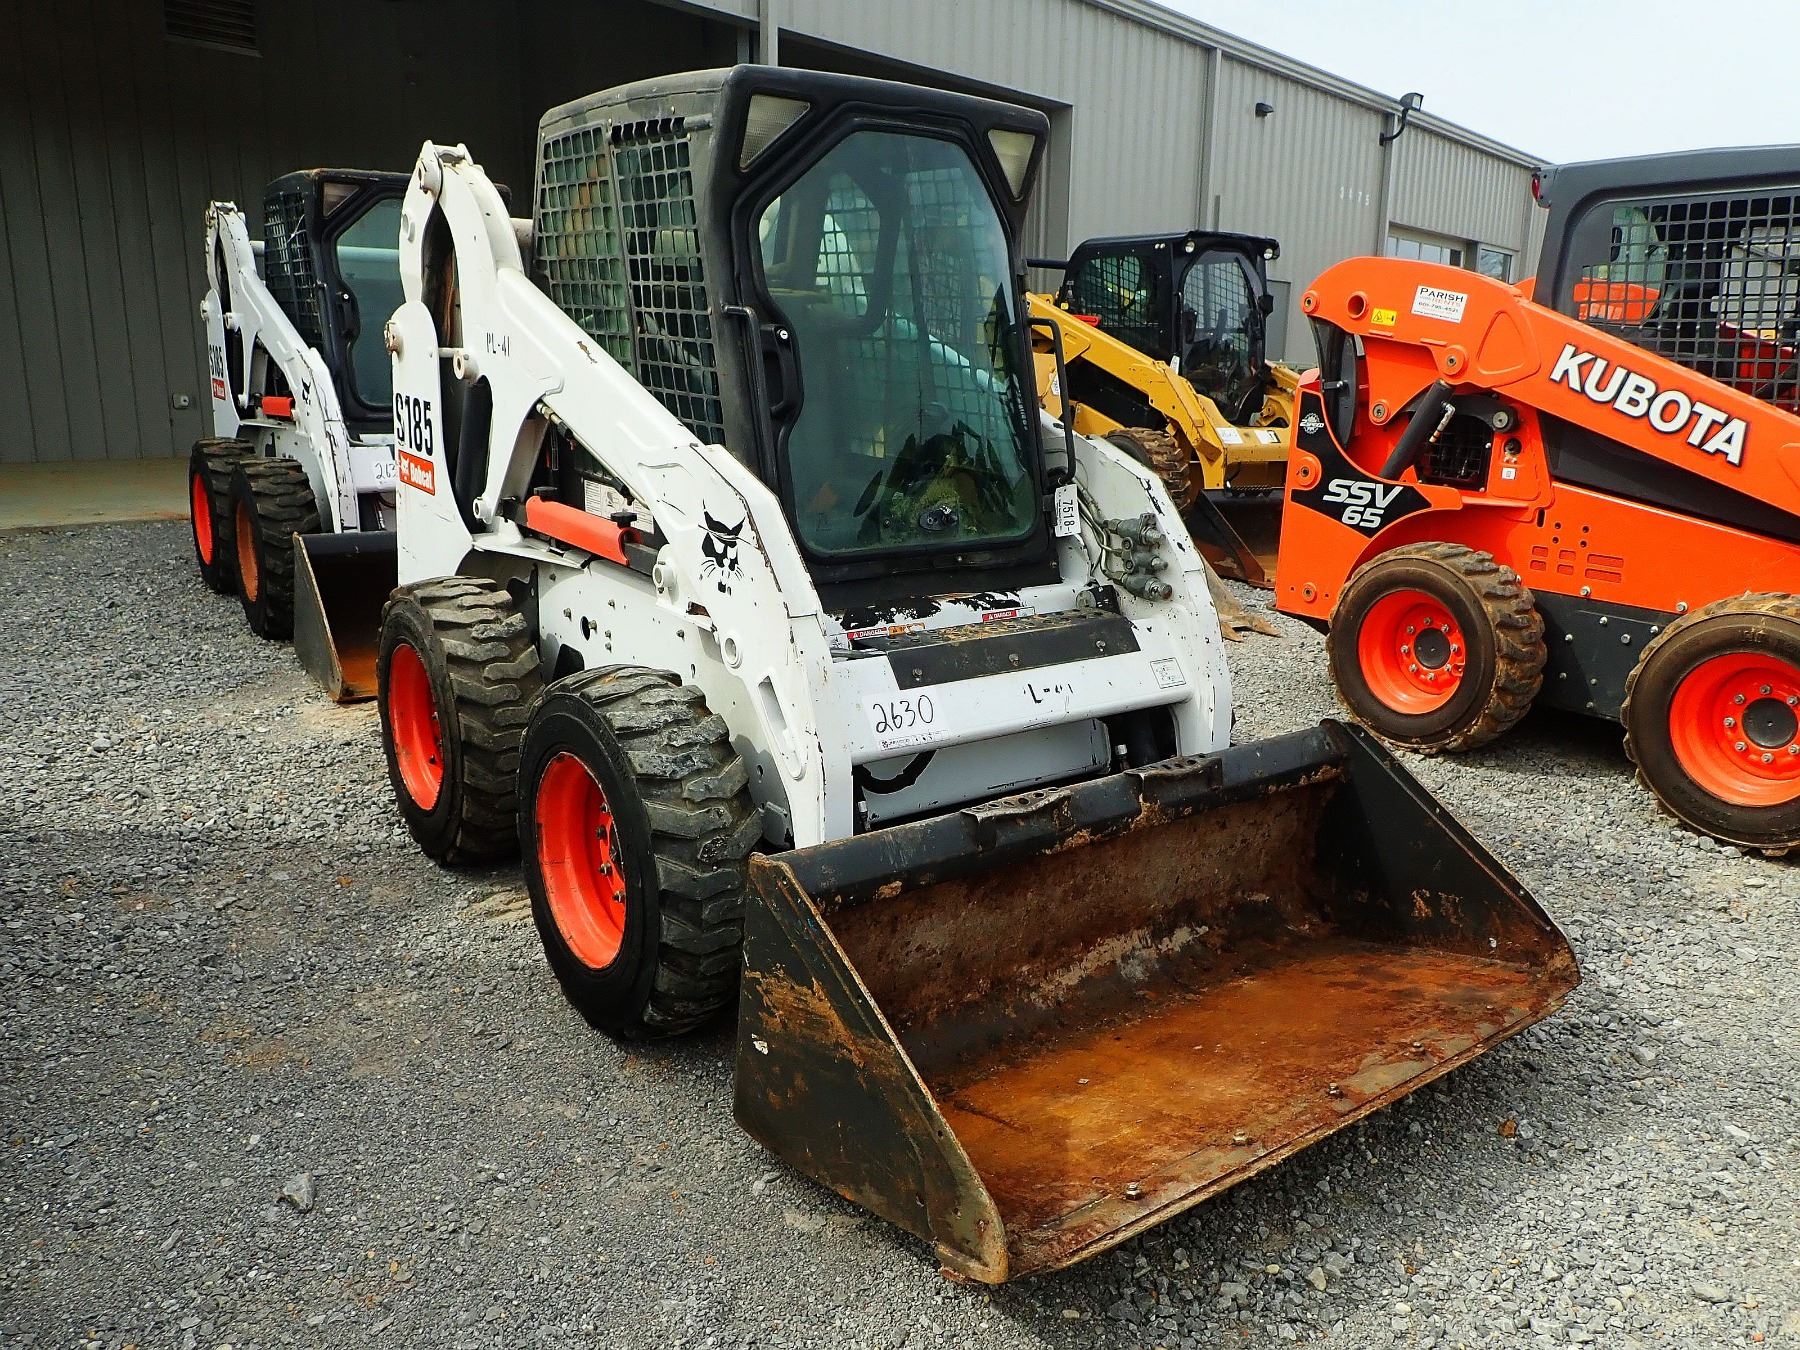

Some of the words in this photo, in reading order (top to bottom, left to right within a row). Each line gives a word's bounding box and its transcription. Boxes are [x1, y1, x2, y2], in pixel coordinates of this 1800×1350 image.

[1420, 287, 1464, 303] PARISH
[1550, 343, 1748, 467] KUBOTA
[395, 392, 434, 456] S185
[410, 461, 434, 490] Bobcat
[1322, 478, 1404, 509] SSV
[1341, 505, 1384, 529] 65
[859, 629, 883, 638] DANGER
[873, 694, 934, 734] 2630
